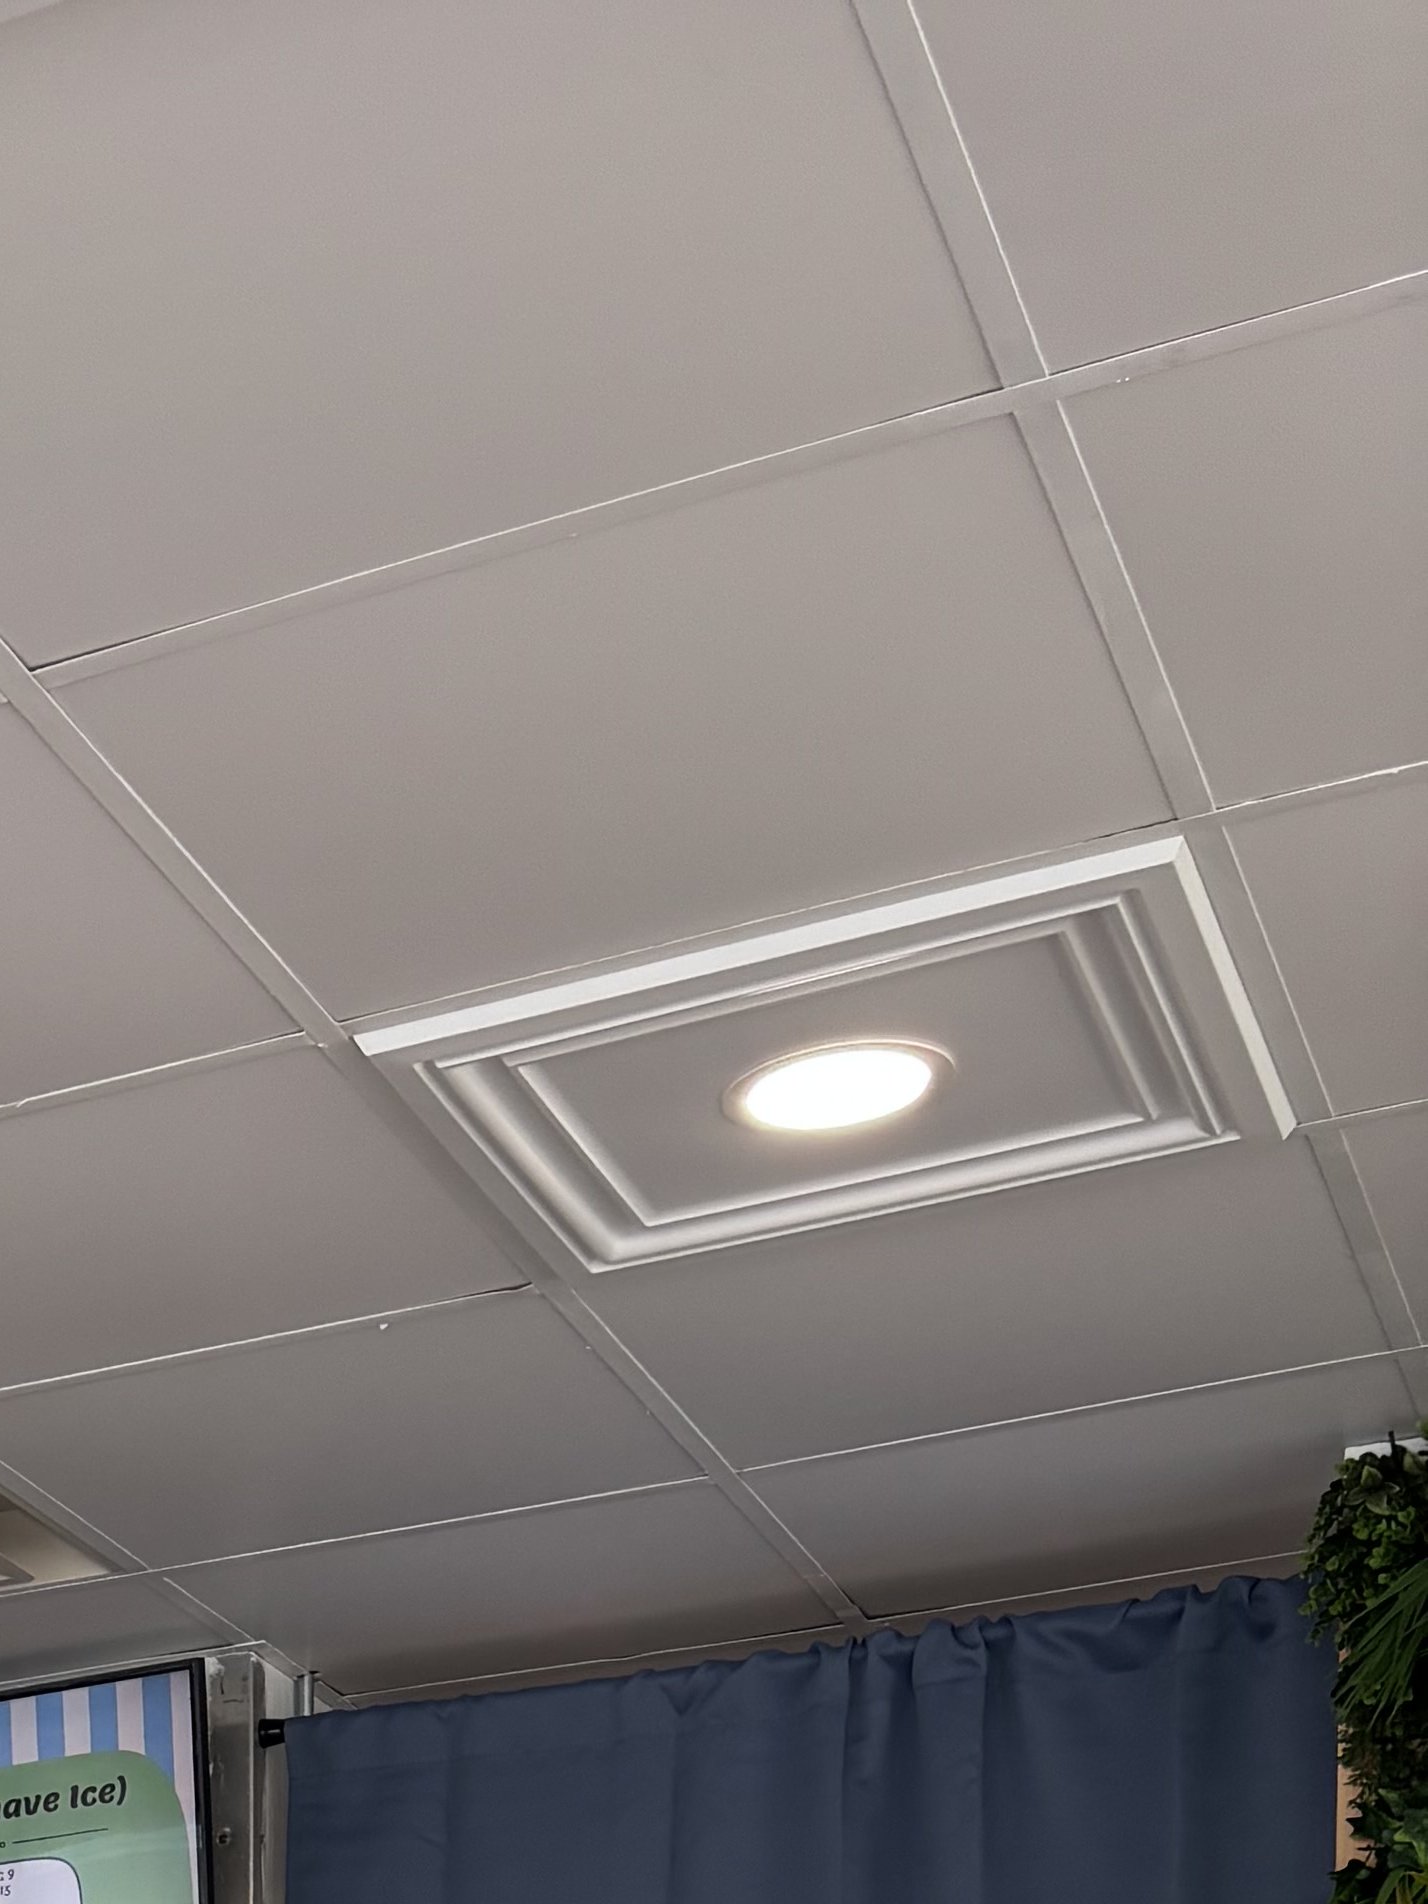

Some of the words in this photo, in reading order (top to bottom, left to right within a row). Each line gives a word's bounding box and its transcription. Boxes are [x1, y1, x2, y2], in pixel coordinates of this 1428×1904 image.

[70, 1775, 128, 1808] Ice)
[7, 1869, 14, 1880] 9
[0, 1885, 11, 1896] 15
